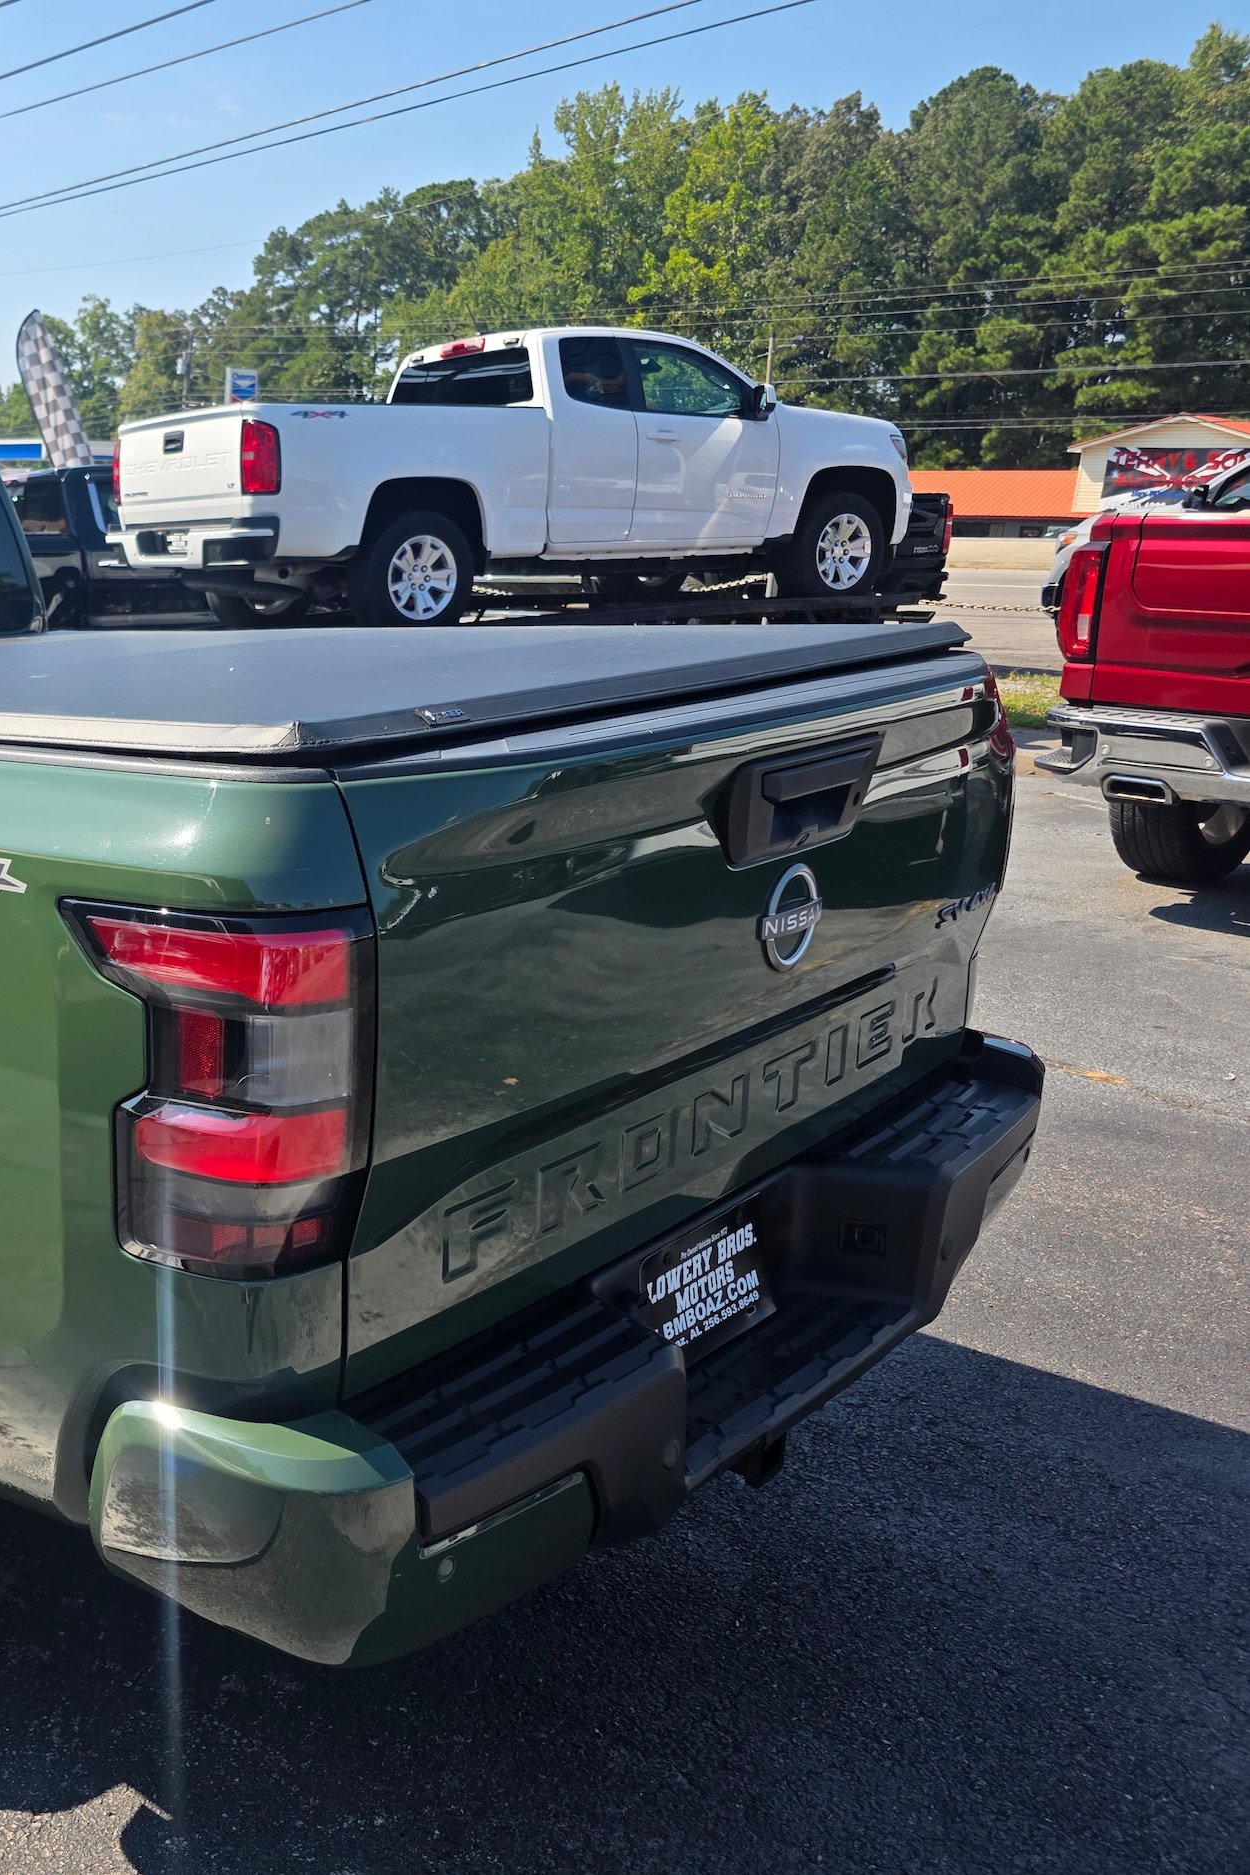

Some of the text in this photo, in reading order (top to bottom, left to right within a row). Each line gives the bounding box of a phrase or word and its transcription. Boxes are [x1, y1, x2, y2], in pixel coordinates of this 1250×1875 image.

[124, 452, 233, 477] CHEVROLET
[764, 903, 822, 937] NISSAN
[442, 976, 938, 1284] FRONTIER
[646, 1222, 757, 1304] LOWERY BROS.
[675, 1260, 735, 1314] MOTORS
[655, 1269, 760, 1341] BMBOAZ.COM
[690, 1325, 703, 1340] AL
[702, 1290, 760, 1331] 256.593.8649
